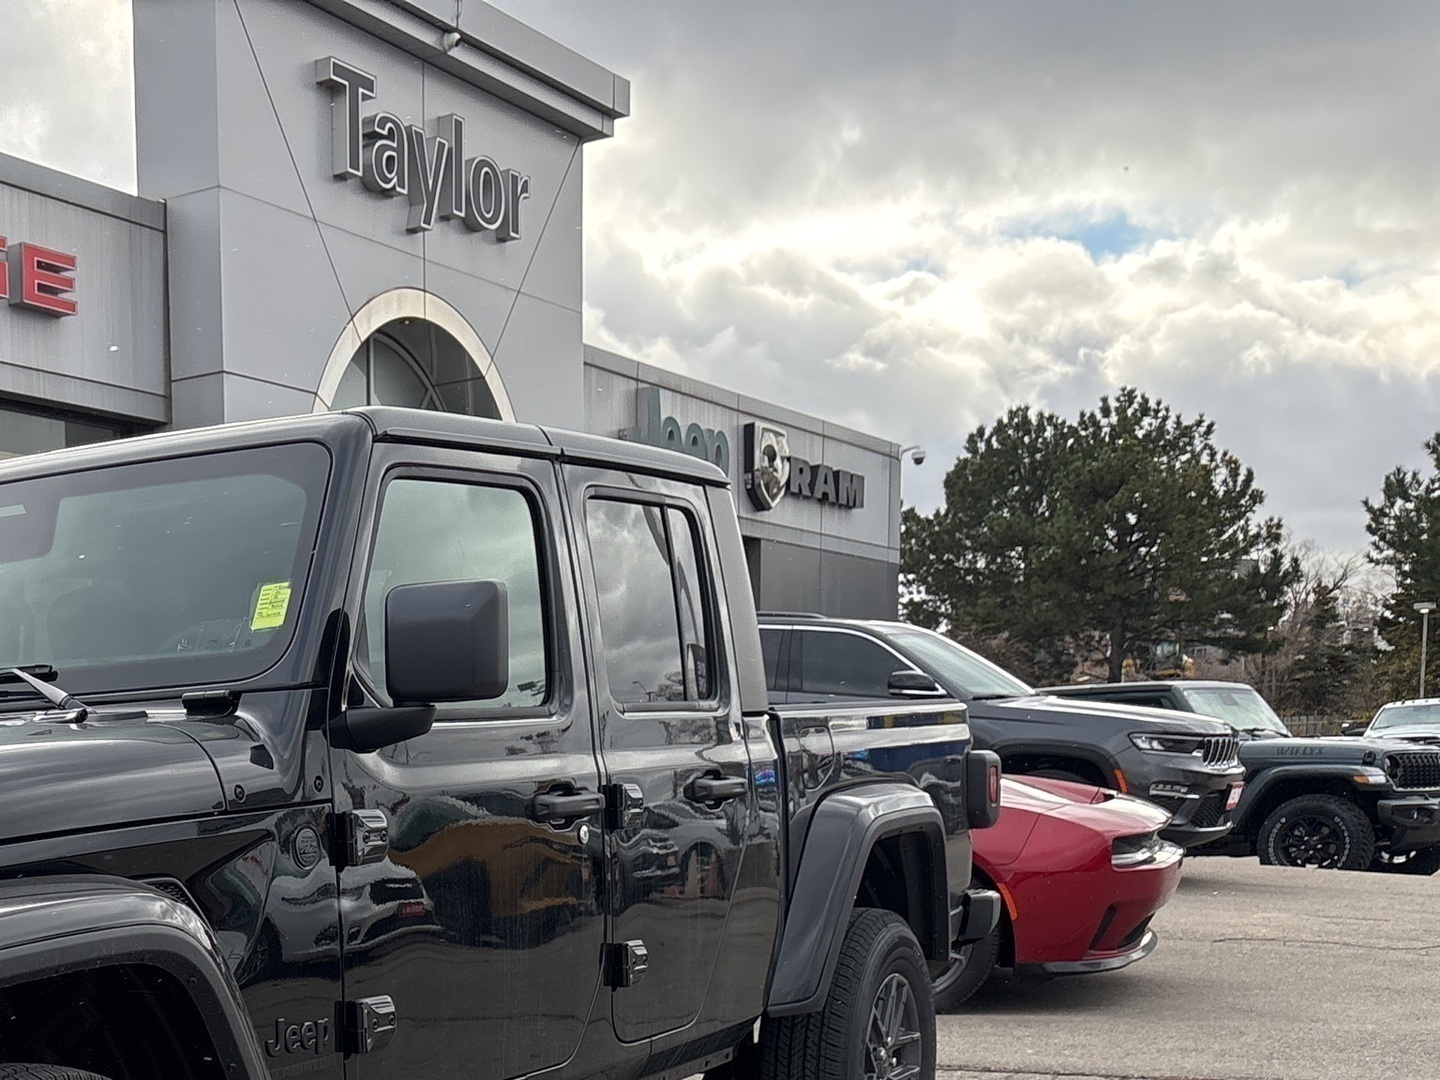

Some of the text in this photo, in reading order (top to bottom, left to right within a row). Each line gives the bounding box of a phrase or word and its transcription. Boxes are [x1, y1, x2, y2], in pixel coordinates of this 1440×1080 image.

[315, 56, 530, 241] Taylor
[786, 455, 866, 509] RAM
[1277, 747, 1324, 756] WILLYS
[264, 1018, 330, 1058] Jeep
